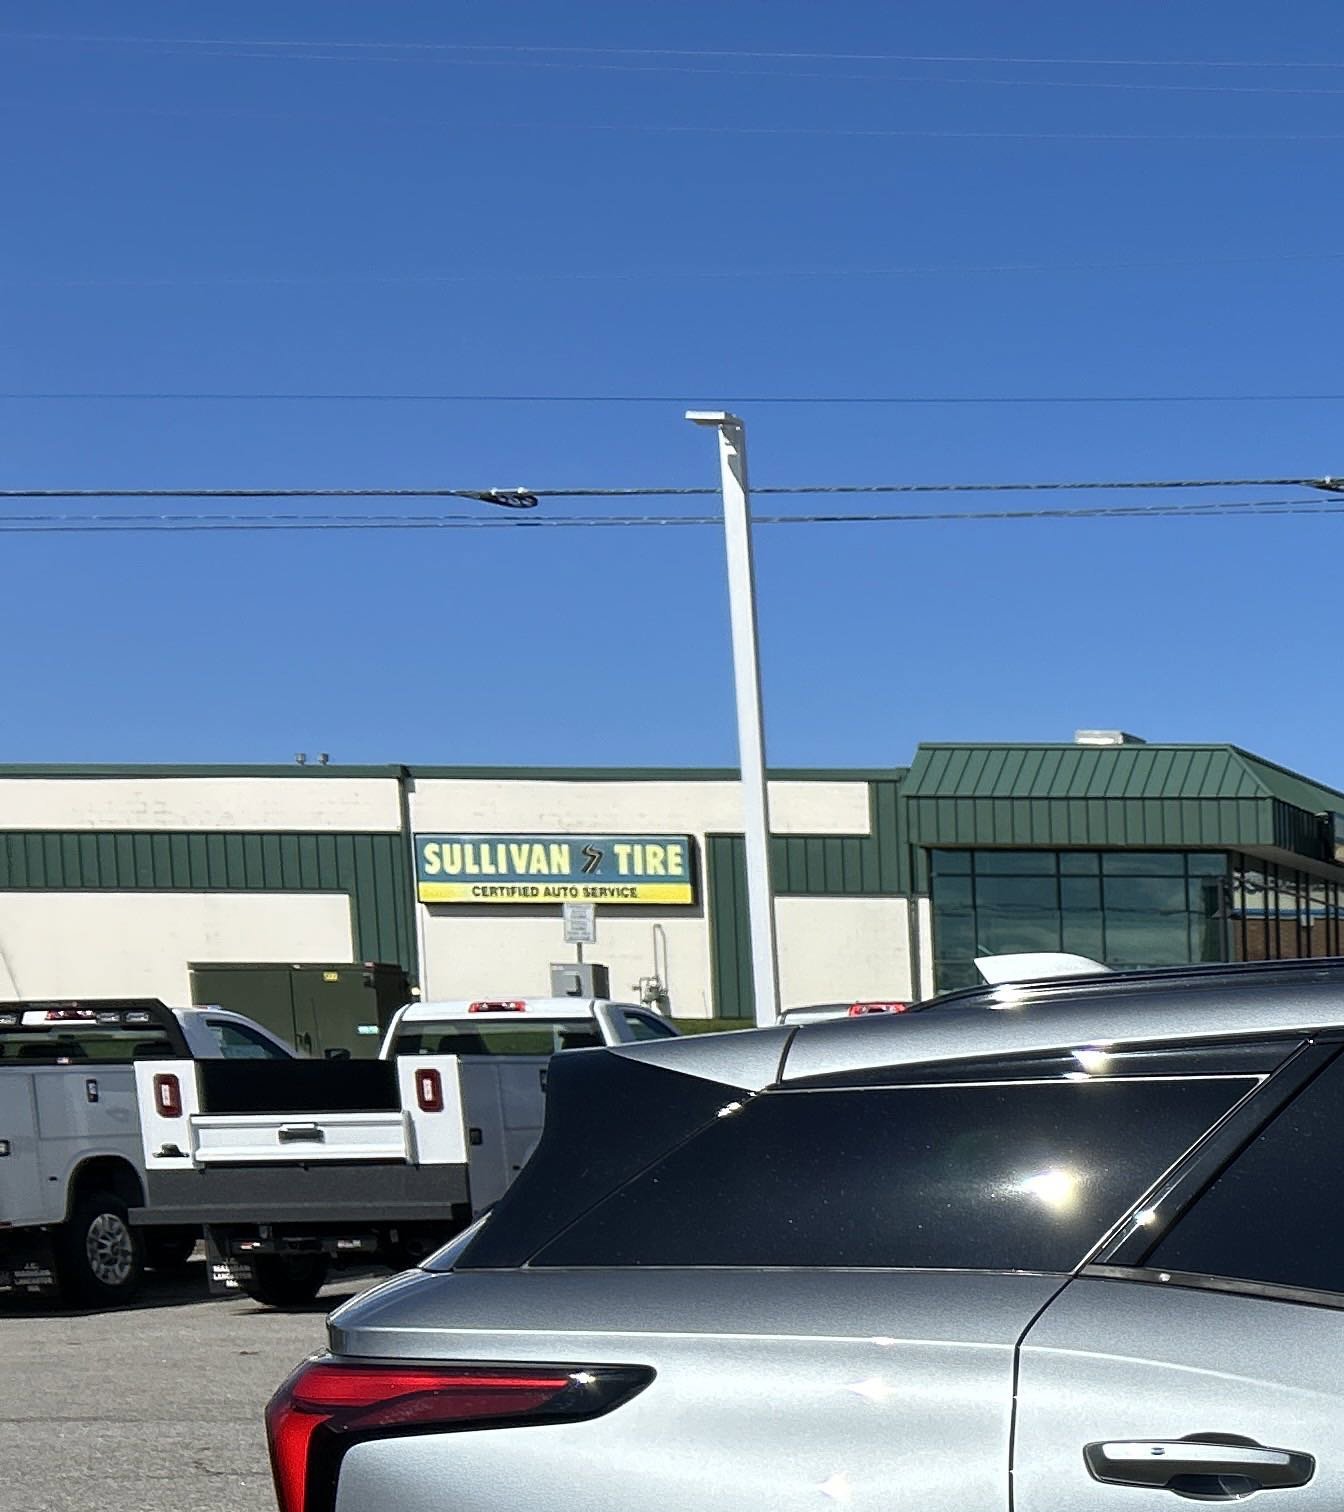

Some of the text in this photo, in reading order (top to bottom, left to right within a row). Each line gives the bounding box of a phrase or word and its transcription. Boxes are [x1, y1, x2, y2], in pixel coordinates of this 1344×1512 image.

[423, 842, 684, 876] SULLIVAN TIRE
[472, 886, 637, 899] CERTIFIED AUTO SERVICE
